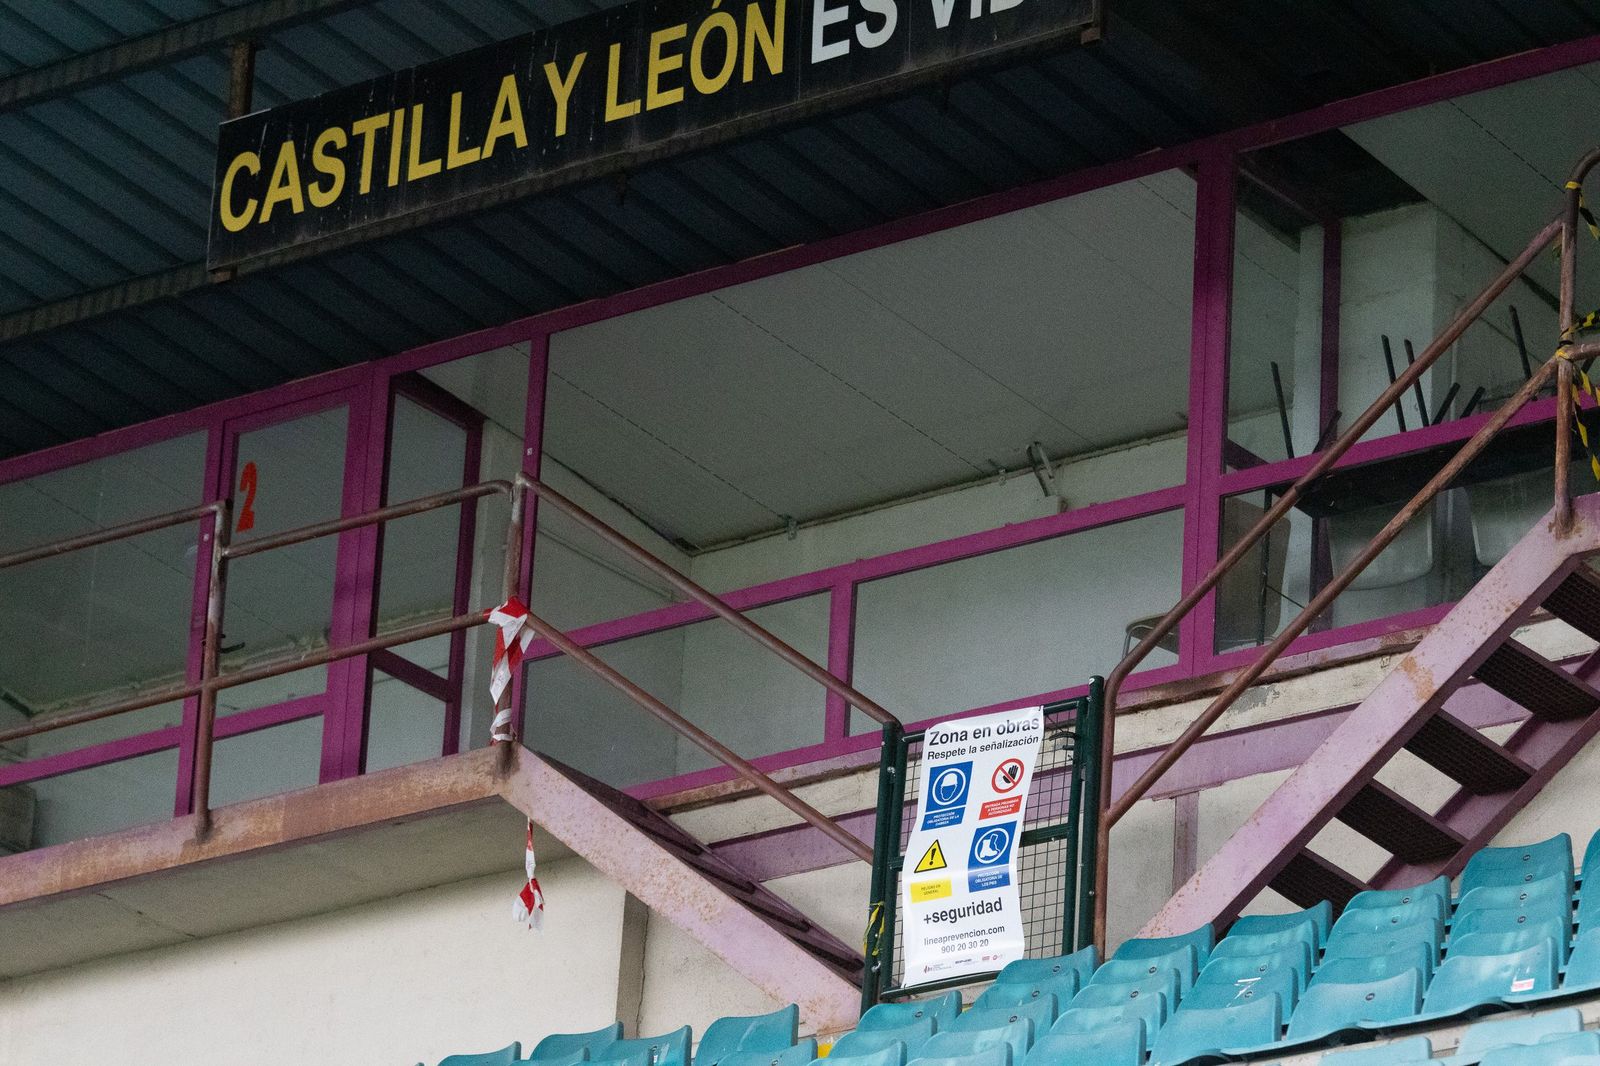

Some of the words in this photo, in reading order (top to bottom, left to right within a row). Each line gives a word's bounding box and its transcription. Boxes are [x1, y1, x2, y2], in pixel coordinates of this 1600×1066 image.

[219, 74, 528, 232] CASTILLA
[543, 52, 588, 137] Y
[604, 0, 786, 122] LEÓN
[811, 0, 899, 64] ES
[236, 461, 257, 533] 2
[928, 731, 968, 746] Zona
[973, 728, 991, 739] en
[996, 718, 1040, 735] obras
[927, 747, 966, 760] Respete
[968, 745, 977, 755] la
[979, 735, 1039, 753] señalización
[923, 897, 1003, 924] +seguridad
[924, 925, 1005, 946] lineaprevencion.com
[941, 944, 956, 954] 900
[957, 943, 967, 952] 20
[968, 940, 978, 950] 30
[979, 938, 989, 948] 20
